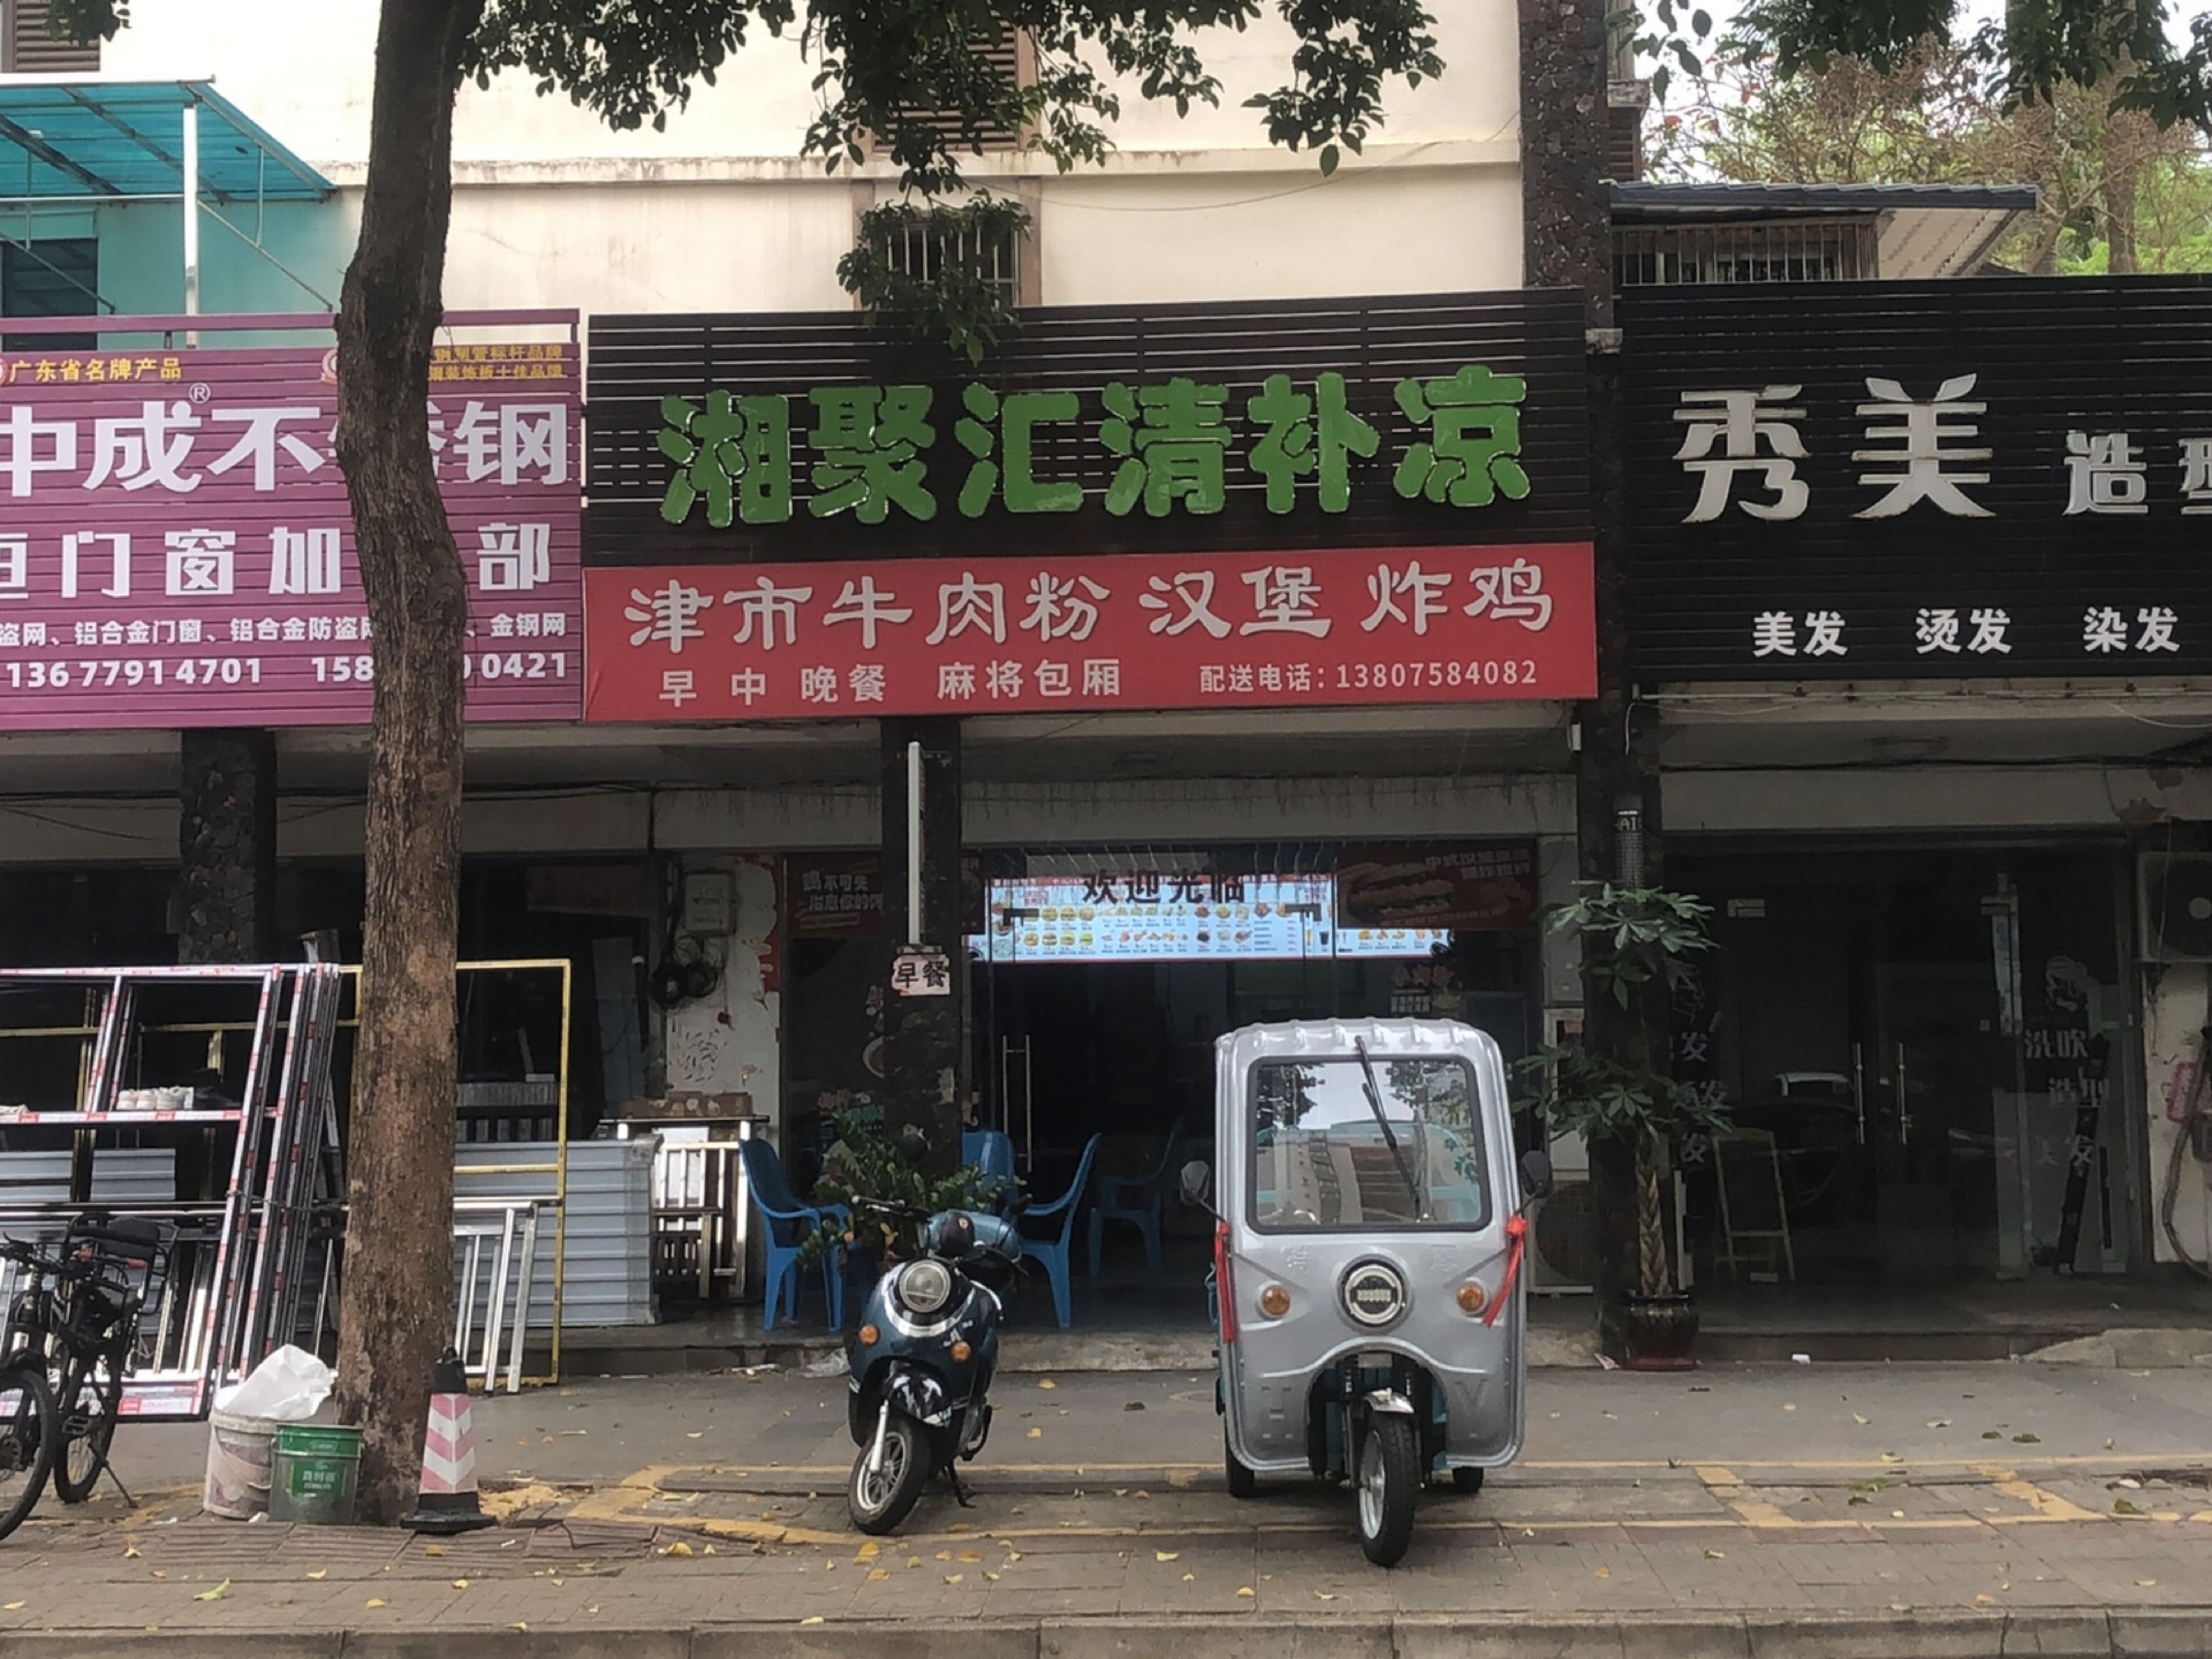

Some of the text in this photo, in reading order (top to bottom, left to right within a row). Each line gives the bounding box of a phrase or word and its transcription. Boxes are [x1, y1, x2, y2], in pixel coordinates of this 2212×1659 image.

[9, 357, 183, 383] 广东省名牌产品
[0, 399, 568, 497] 中成不钢
[657, 365, 1532, 529] 湘聚汇清补凉
[1671, 373, 1998, 524] 秀美
[0, 524, 550, 599] 门窗加部
[624, 557, 1553, 653] 津市牛肉粉 汉堡 炸鸡
[1752, 605, 2181, 658] 美发 烫发 染发
[659, 669, 697, 707] 早
[731, 668, 767, 705] 中
[801, 664, 887, 702] 晚餐
[937, 659, 1121, 699] 麻将包厢
[1082, 869, 1246, 904] 欢迎光临
[896, 961, 947, 989] 早餐
